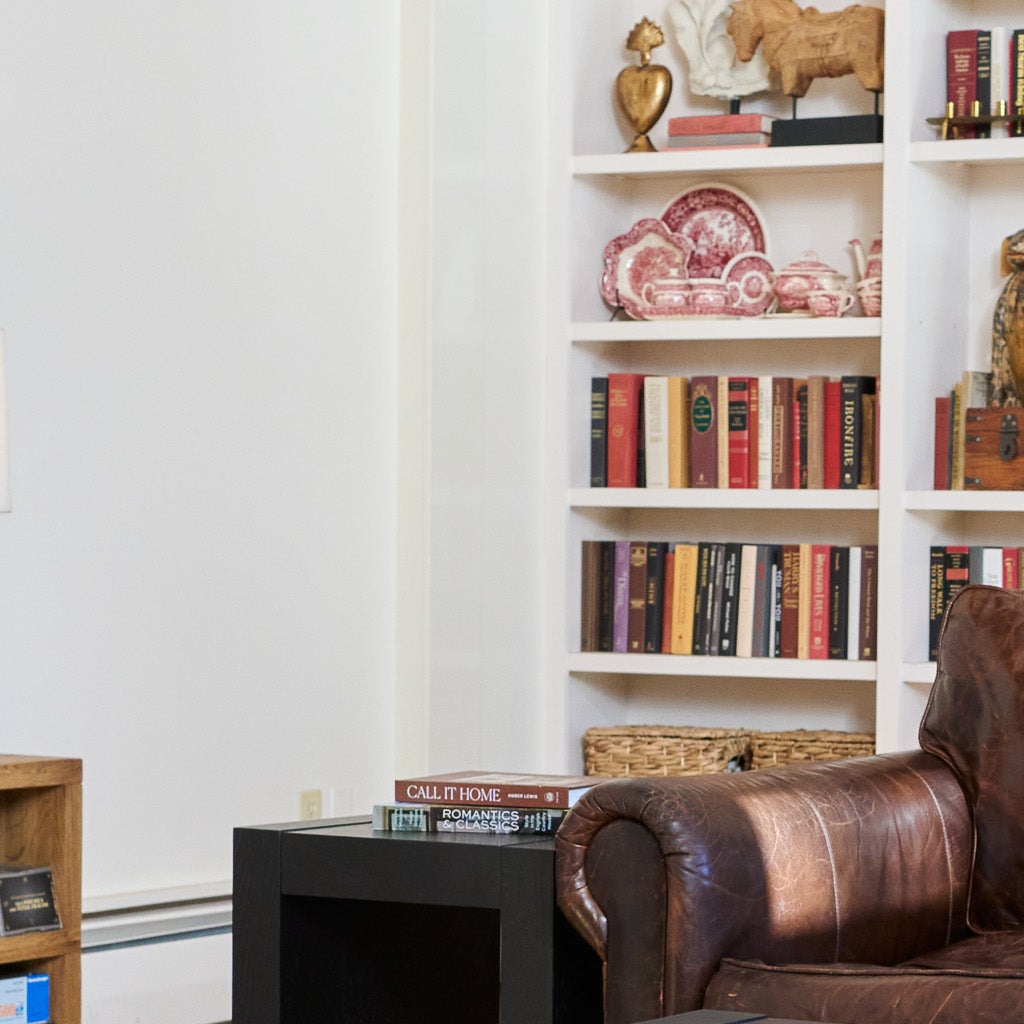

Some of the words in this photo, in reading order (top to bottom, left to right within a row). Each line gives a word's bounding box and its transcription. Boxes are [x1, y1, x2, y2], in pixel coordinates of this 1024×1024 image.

[843, 400, 855, 467] IRONFIRE
[936, 564, 944, 589] LONG
[936, 591, 944, 614] WALK
[407, 784, 441, 800] CALL
[444, 786, 457, 800] IT
[460, 787, 501, 802] HOME
[442, 808, 519, 821] ROMANTICS
[443, 820, 451, 829] &
[455, 819, 519, 831] CLASSICS
